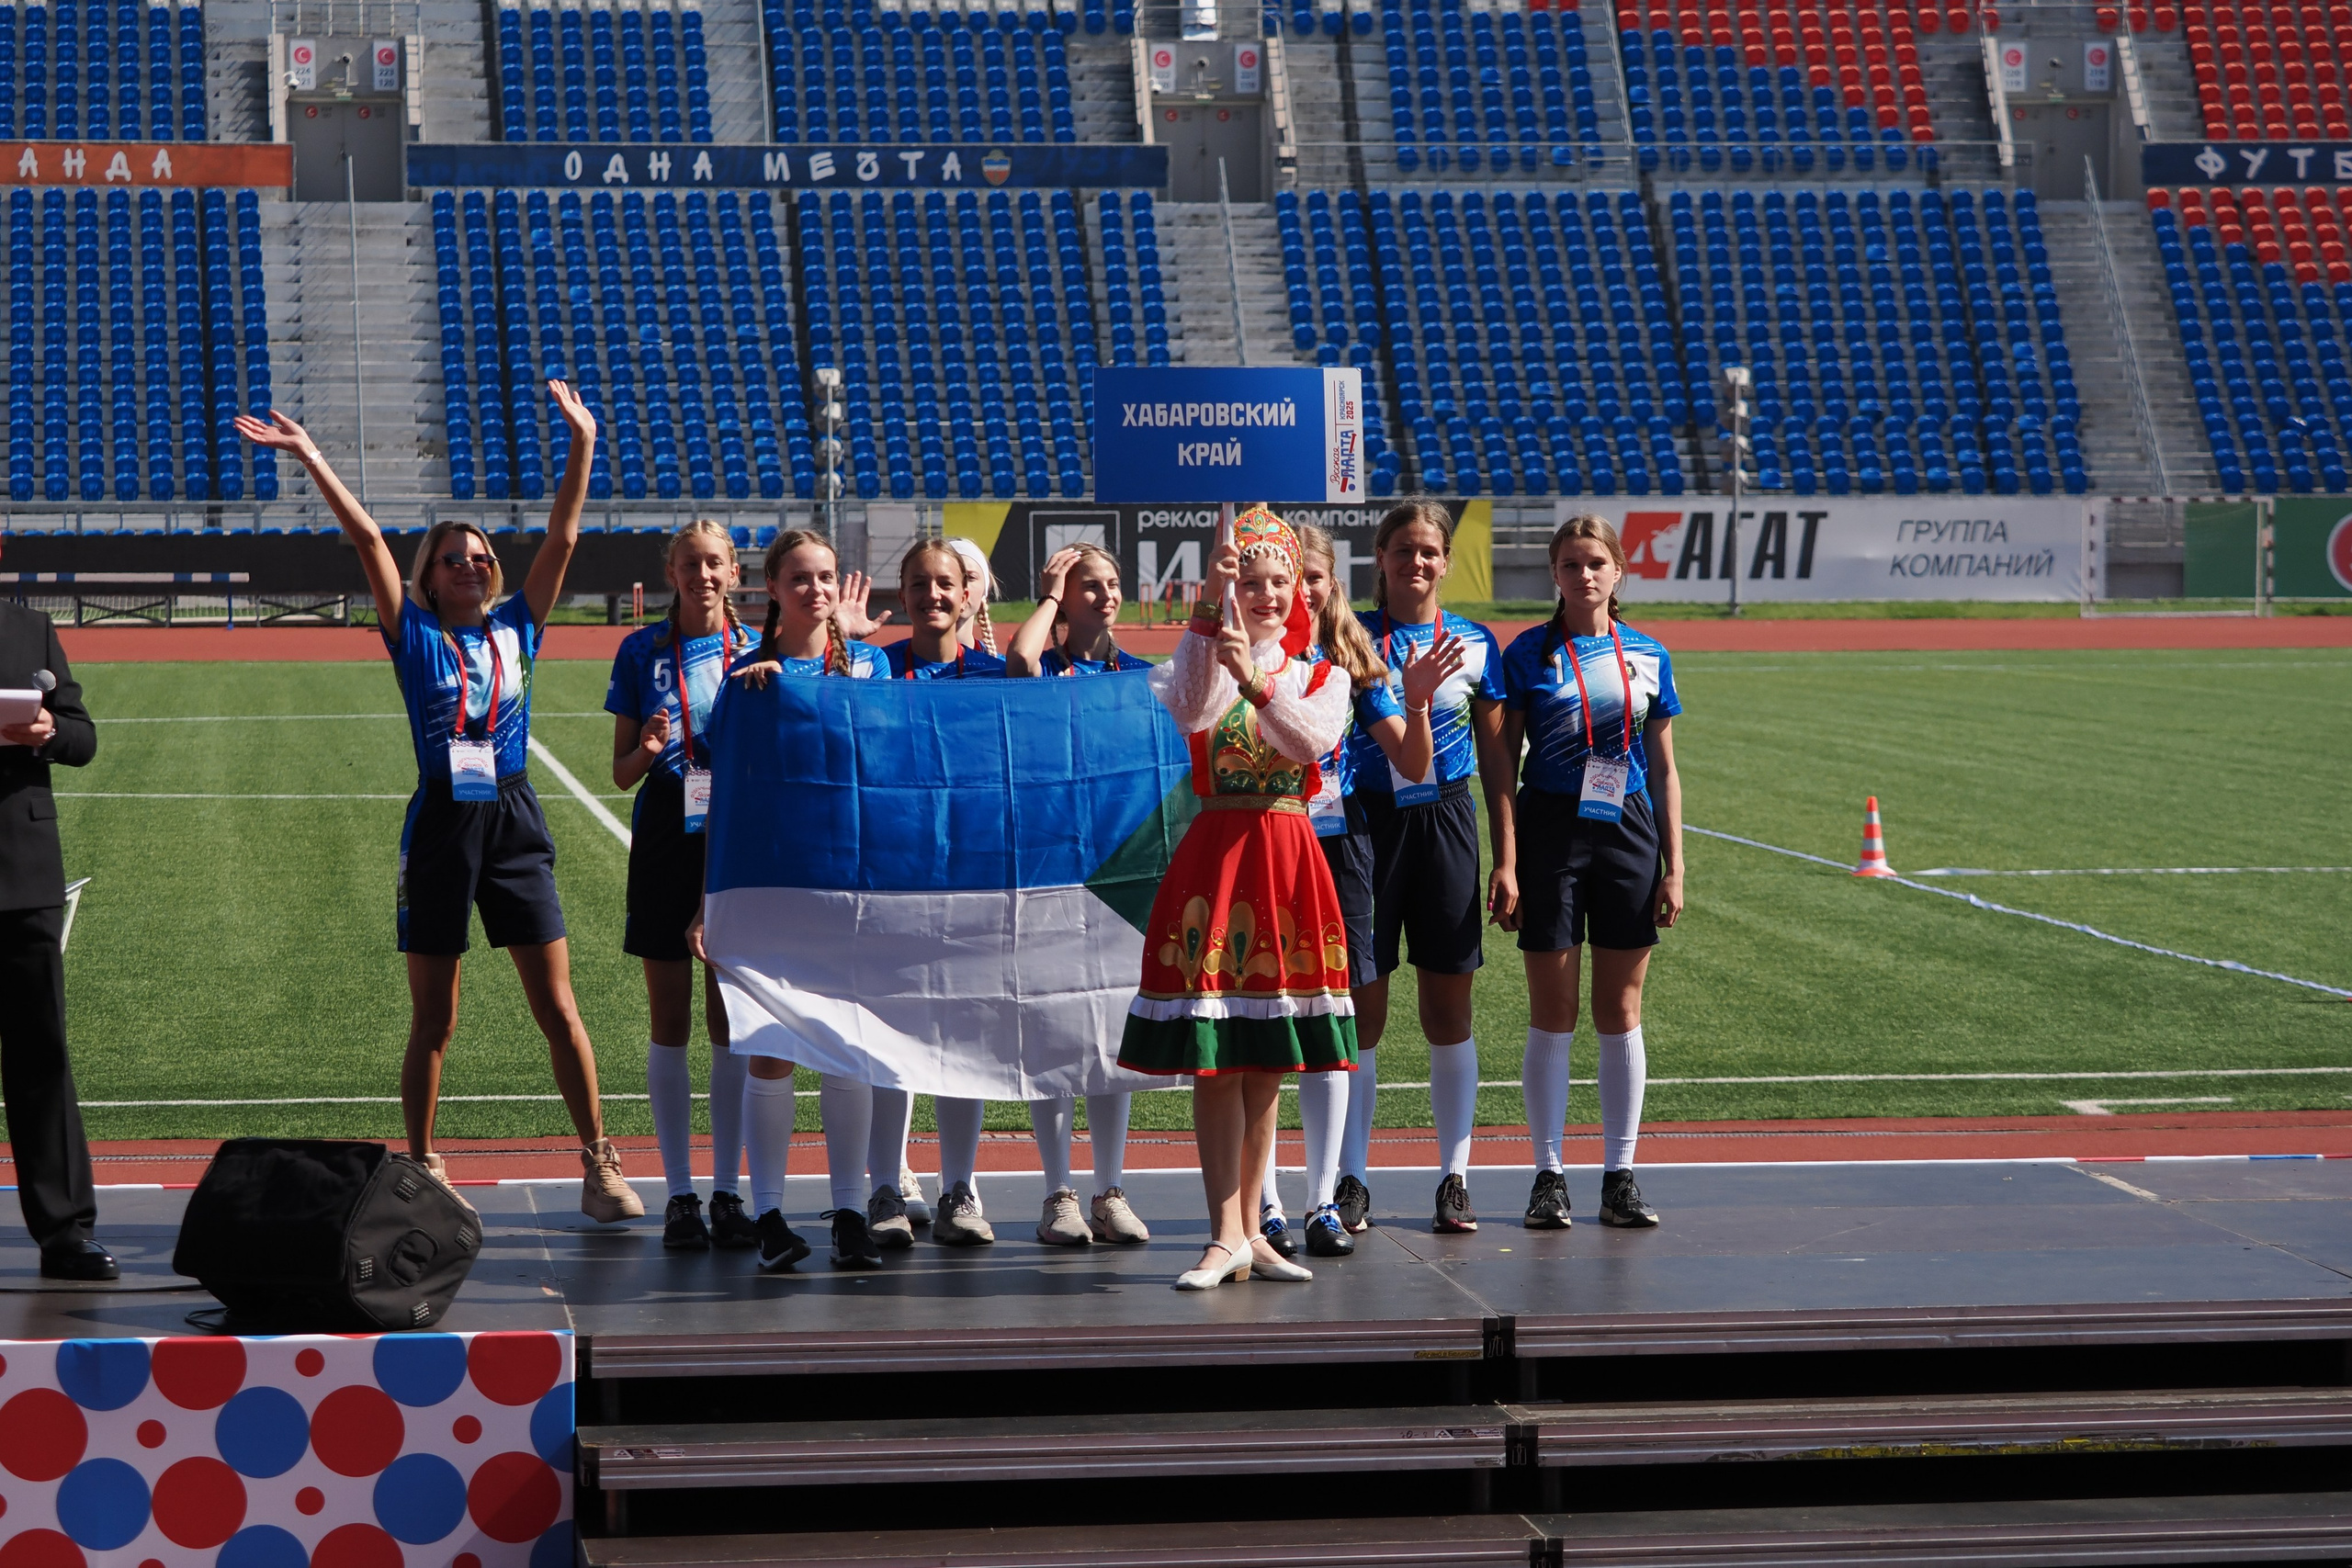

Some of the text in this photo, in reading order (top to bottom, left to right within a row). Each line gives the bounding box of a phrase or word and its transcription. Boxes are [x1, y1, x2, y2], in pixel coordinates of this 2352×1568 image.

[17, 147, 173, 182] АНДА
[563, 150, 713, 184] ОДНА
[1122, 397, 1295, 427] ХАБАРОВСКИЙ
[1338, 380, 1346, 420] КРАСНОЯРСК
[1345, 400, 1354, 419] 2025
[1178, 436, 1241, 466] КРАЙ
[1340, 429, 1355, 480] ЛАПТА
[1283, 510, 1391, 526] компани
[1896, 520, 2008, 543] ГРУППА
[1675, 512, 1828, 580] АГАТ
[1889, 548, 2055, 578] КОМПАНИЙ
[654, 658, 672, 693] 5
[1554, 653, 1564, 684] 1
[1399, 790, 1434, 801] УЧАСТНИК
[1312, 822, 1341, 830] ЧАСТНИК
[1584, 806, 1617, 818] УЧАСТНИК
